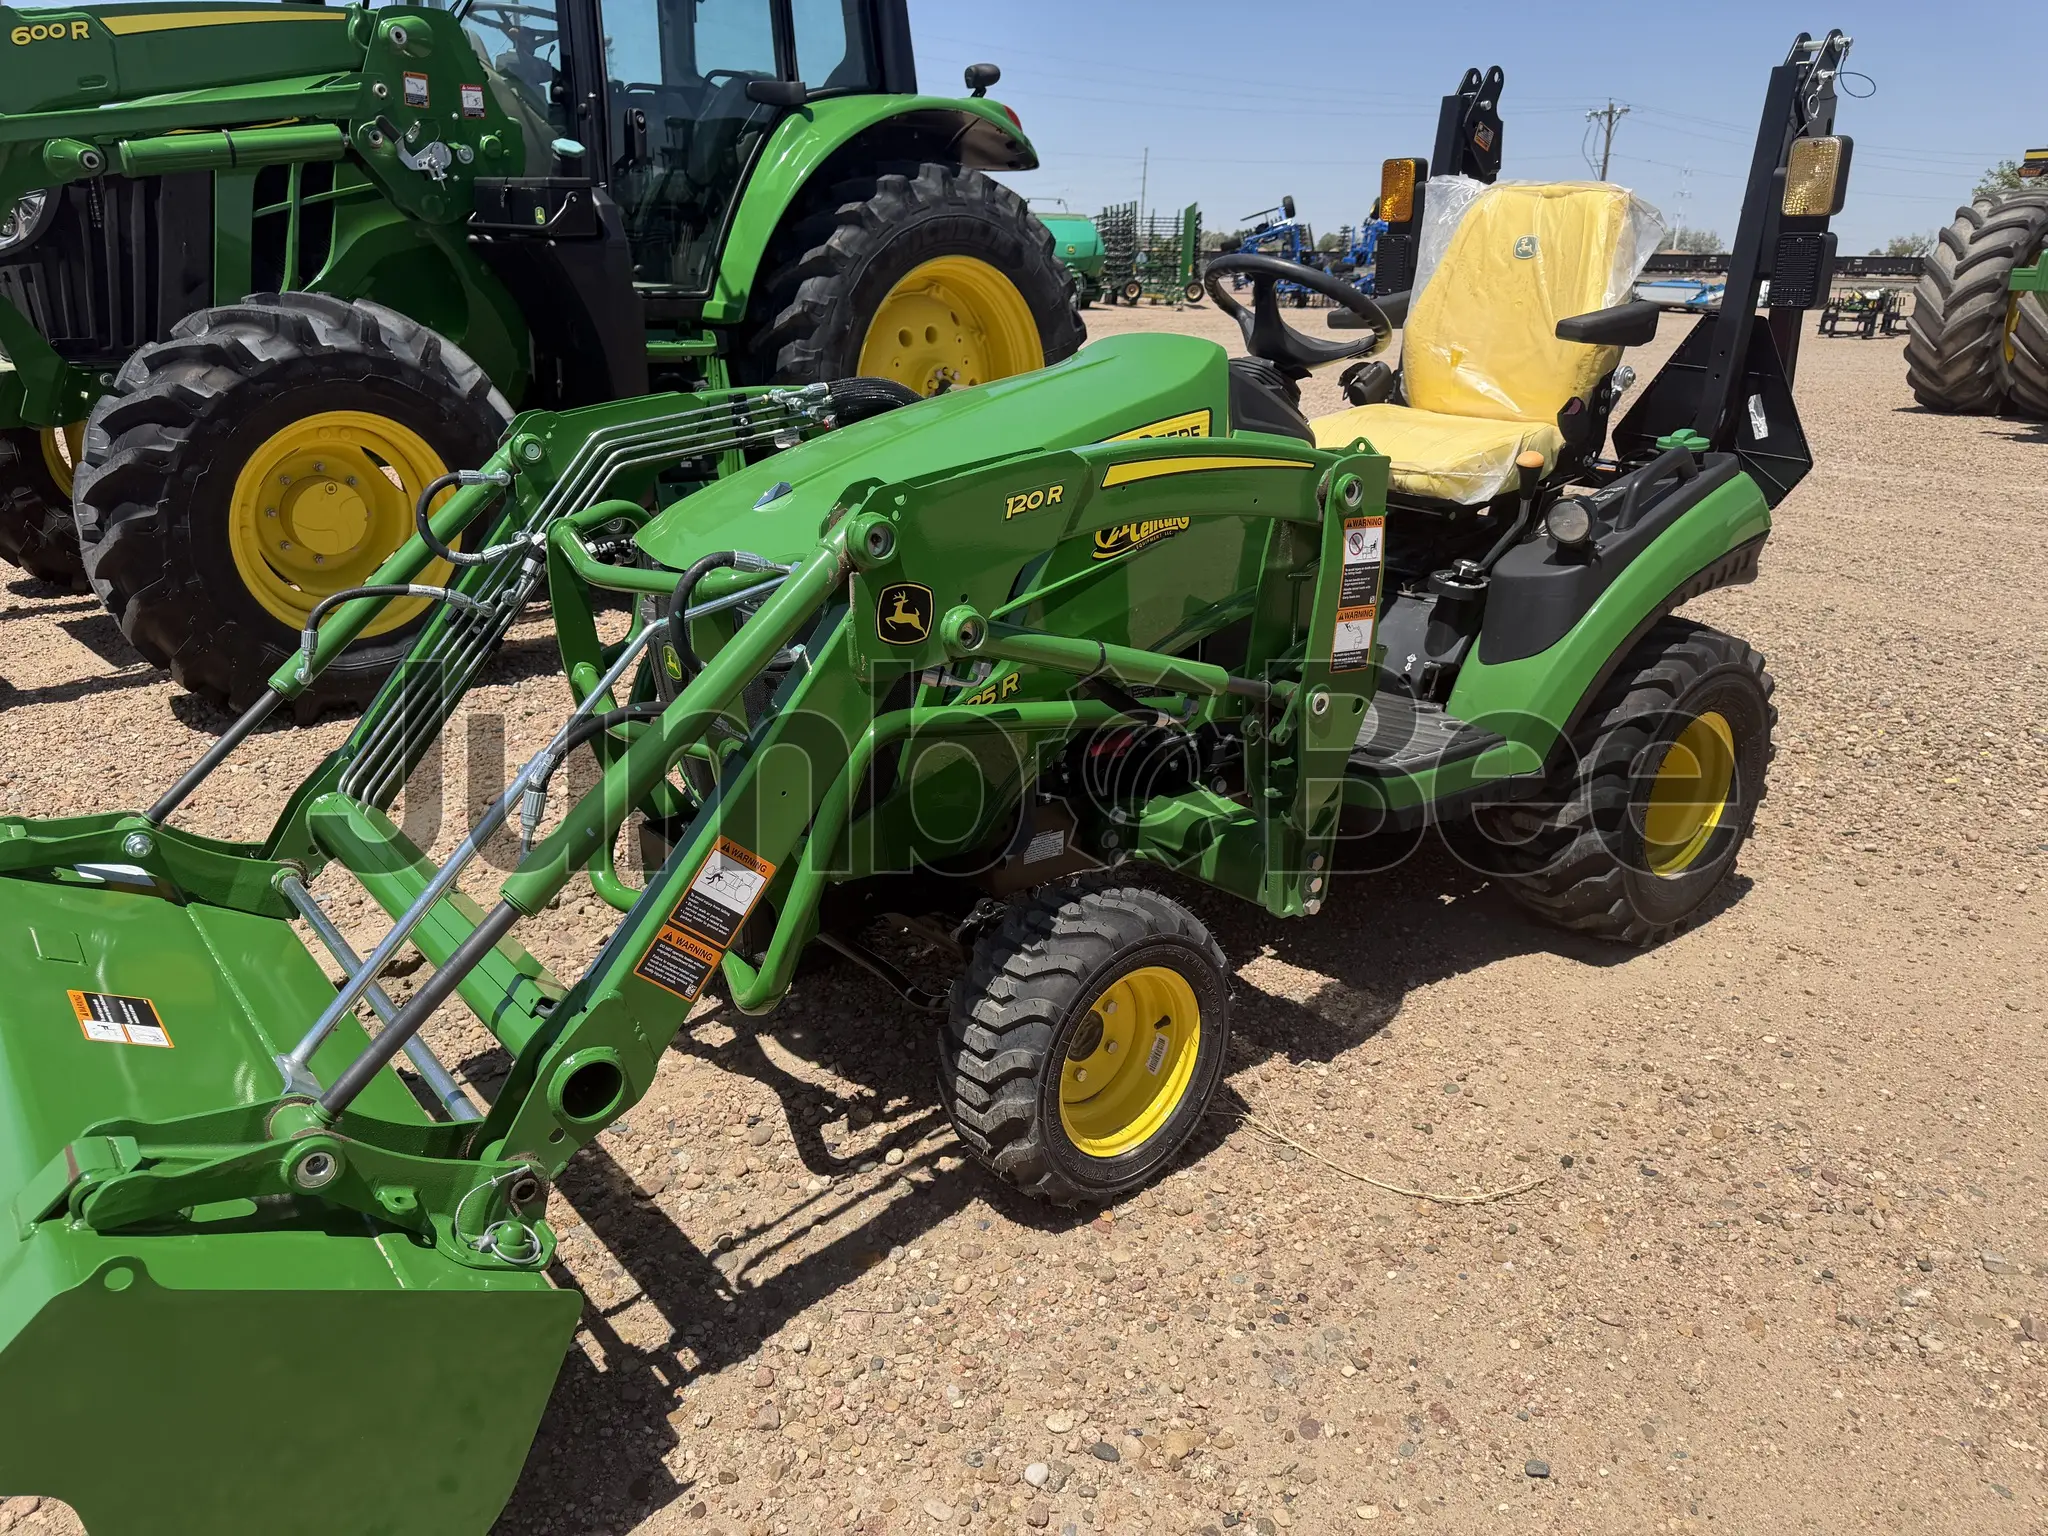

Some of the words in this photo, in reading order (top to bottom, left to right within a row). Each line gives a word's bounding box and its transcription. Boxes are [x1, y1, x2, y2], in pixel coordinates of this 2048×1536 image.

[1353, 517, 1383, 527] WARNING
[1344, 609, 1374, 619] WARNING
[731, 847, 768, 873] WARNING
[675, 936, 714, 963] WARNING
